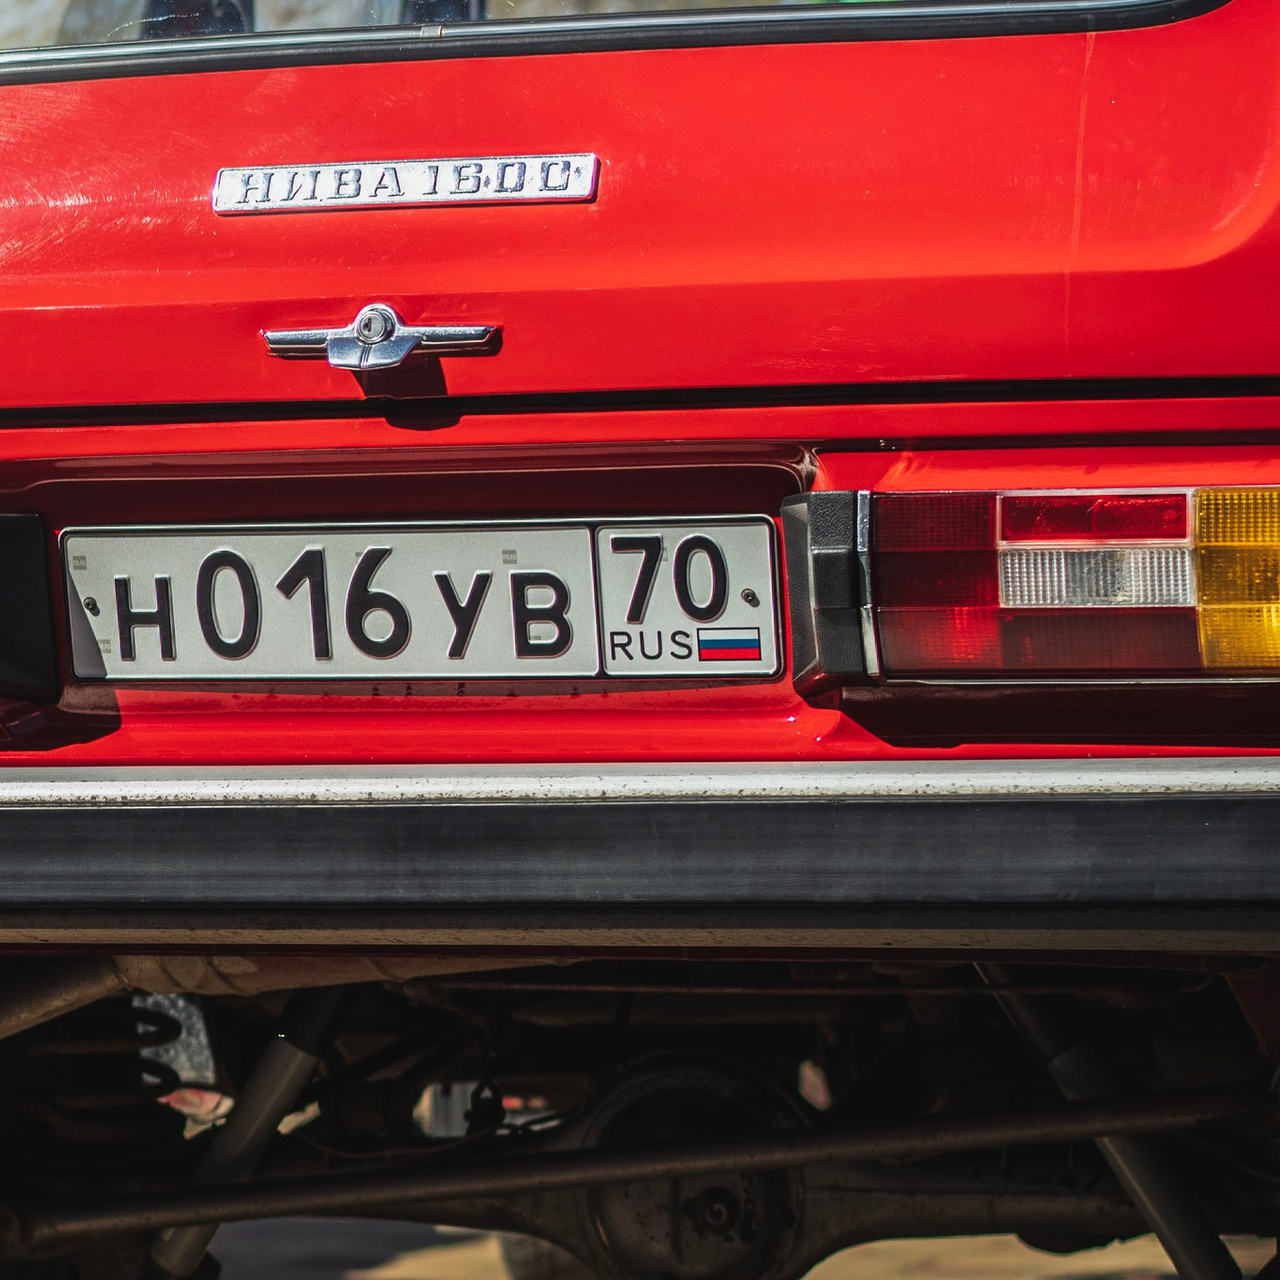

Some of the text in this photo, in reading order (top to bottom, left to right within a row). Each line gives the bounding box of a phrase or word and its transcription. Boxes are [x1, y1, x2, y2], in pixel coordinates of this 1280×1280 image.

[234, 160, 571, 204] НИВА 1600
[610, 535, 727, 623] 70
[609, 630, 693, 661] RUS
